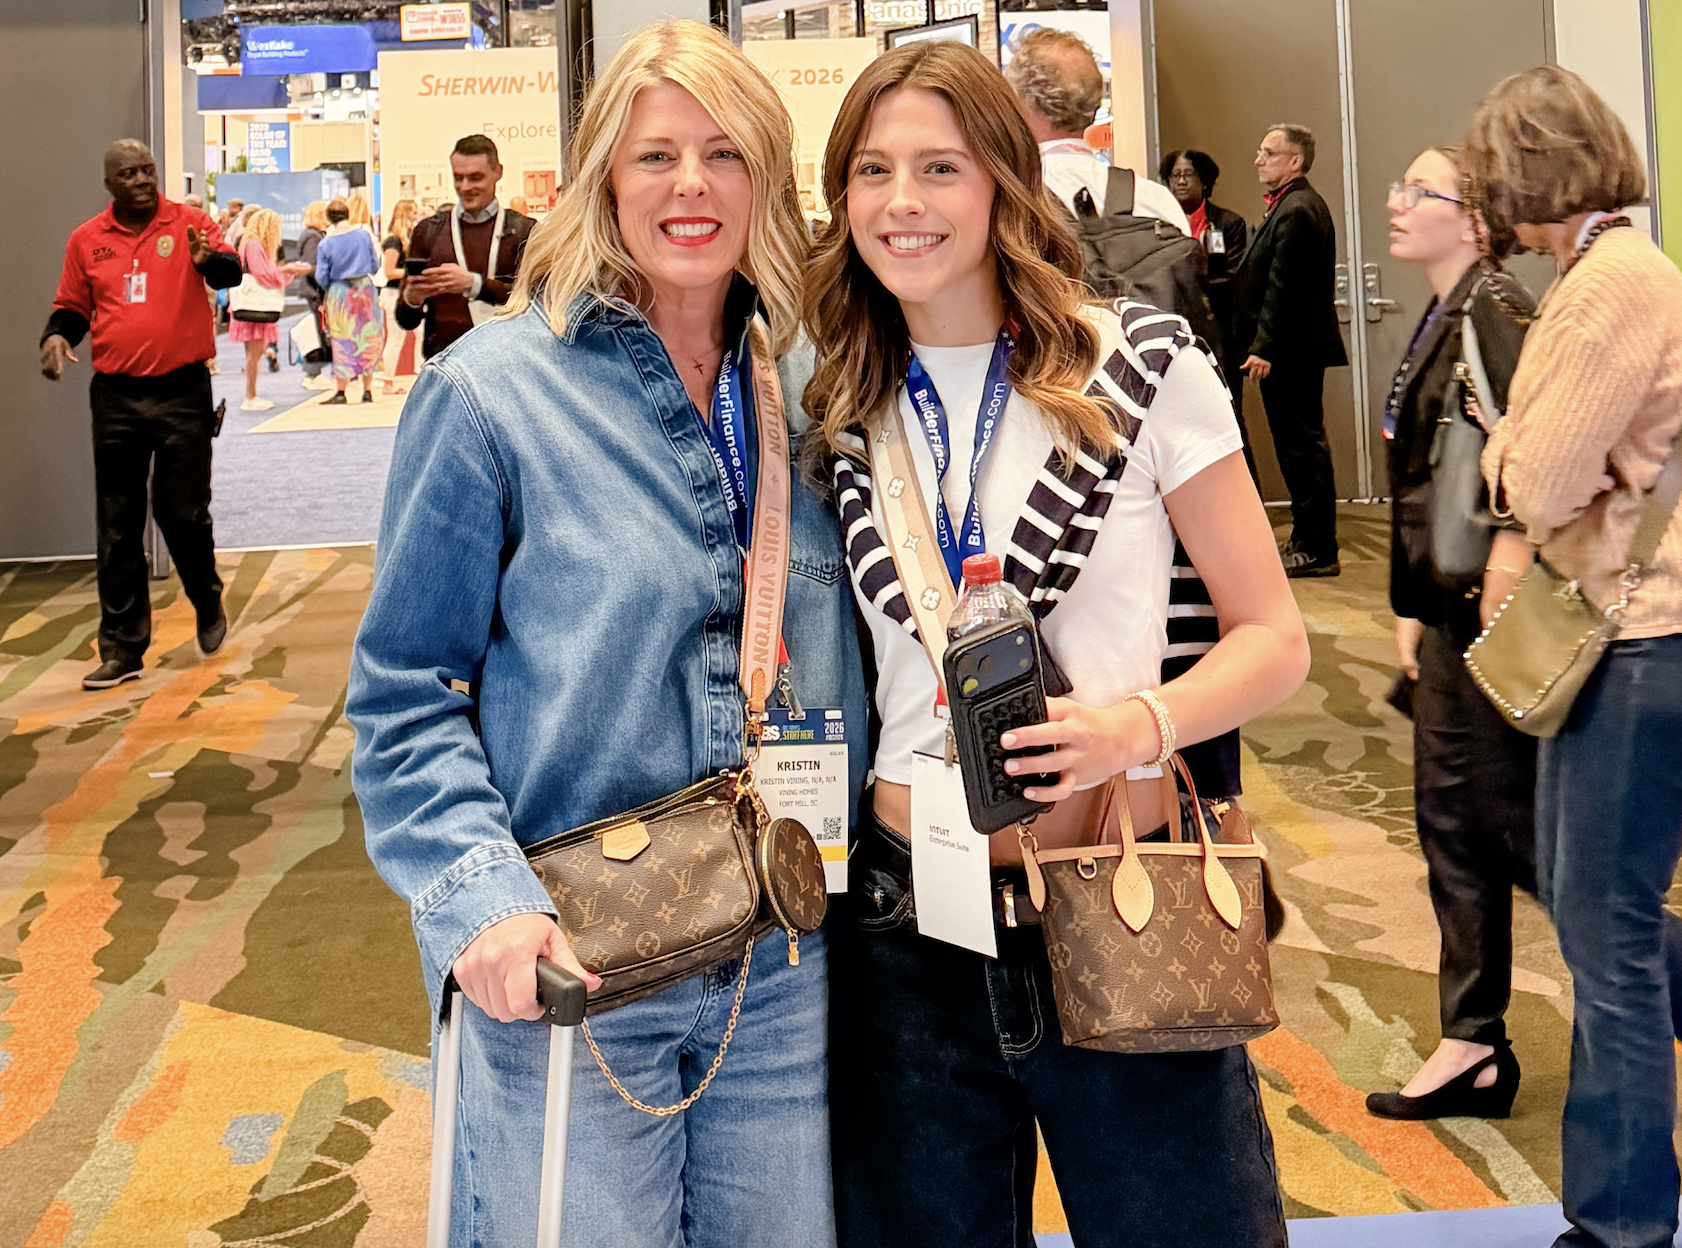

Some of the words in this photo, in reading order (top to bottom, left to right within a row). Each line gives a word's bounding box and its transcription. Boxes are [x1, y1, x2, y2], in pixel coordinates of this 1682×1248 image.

[246, 40, 295, 51] Westlake
[790, 68, 844, 85] 2026
[483, 122, 557, 142] Explore
[758, 379, 782, 456] VUITTON
[760, 505, 782, 565] LOUIS
[752, 572, 776, 665] VUITTON
[761, 724, 781, 741] BS
[824, 722, 845, 734] 2026
[777, 760, 821, 772] KRISTIN
[760, 778, 785, 786] KRISTIN
[786, 777, 810, 785] VINING,
[811, 777, 825, 785] N/A,
[825, 776, 837, 784] N/A
[799, 788, 819, 796] HOMES
[779, 800, 794, 808] FORT
[810, 799, 818, 807] SC
[929, 834, 956, 848] Enterprise
[956, 841, 970, 852] Suite
